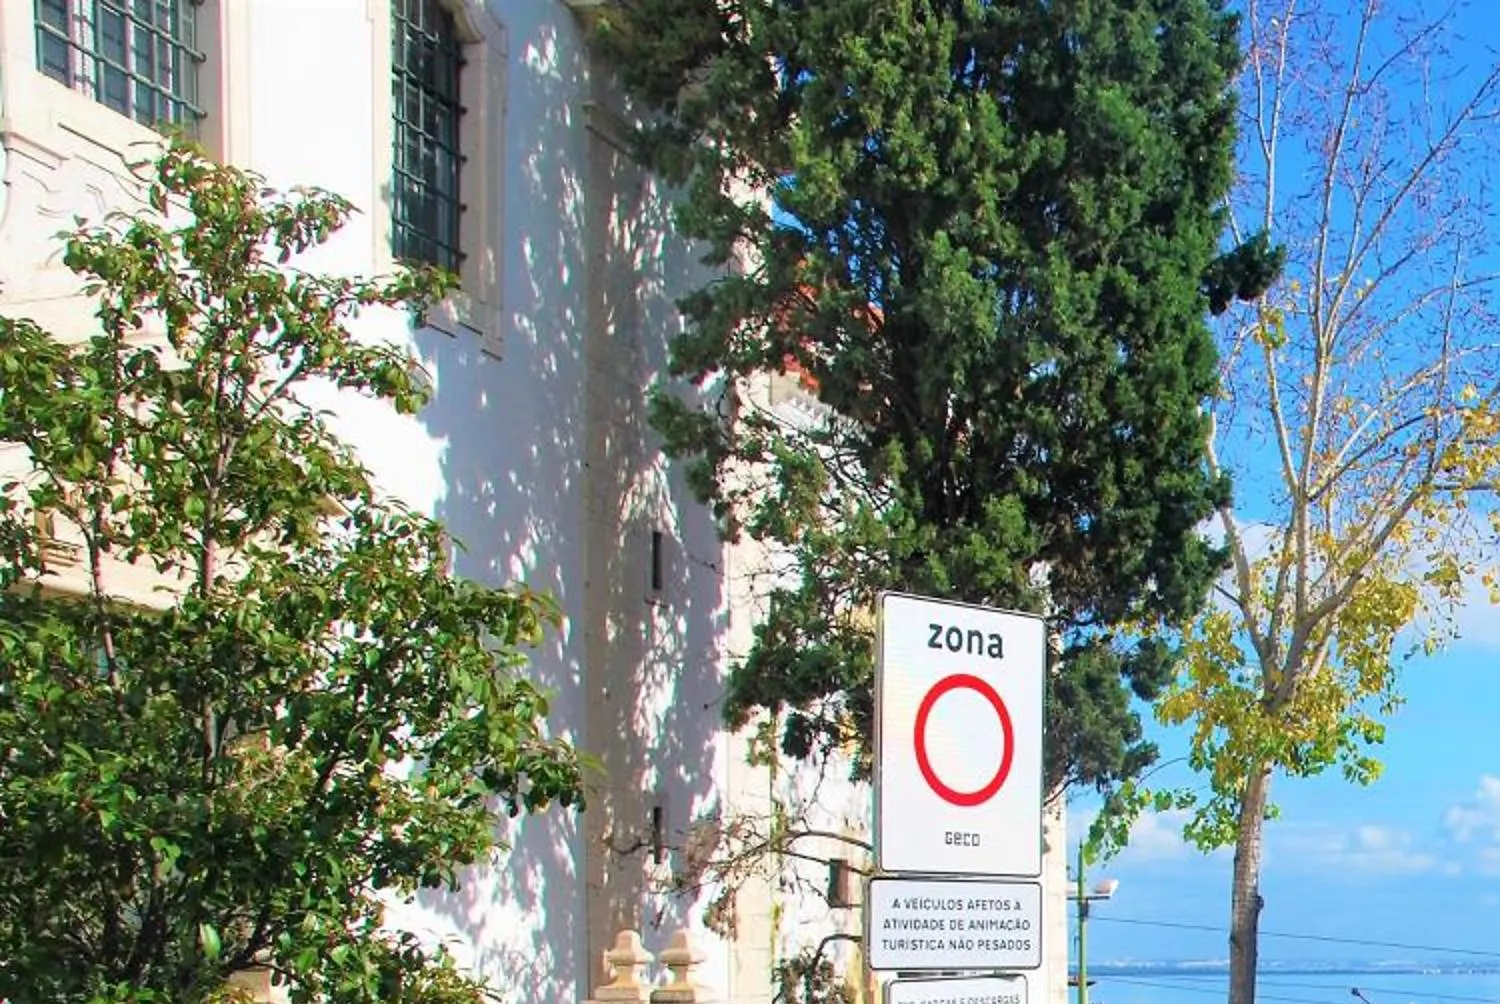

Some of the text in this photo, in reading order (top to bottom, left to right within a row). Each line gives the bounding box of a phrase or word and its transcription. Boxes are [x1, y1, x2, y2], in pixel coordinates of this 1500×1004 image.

[928, 623, 1004, 659] zona
[967, 899, 1011, 911] AFETOS
[883, 918, 945, 930] ATIVIDADE
[949, 919, 965, 930] DE
[978, 939, 1031, 950] PESADOS
